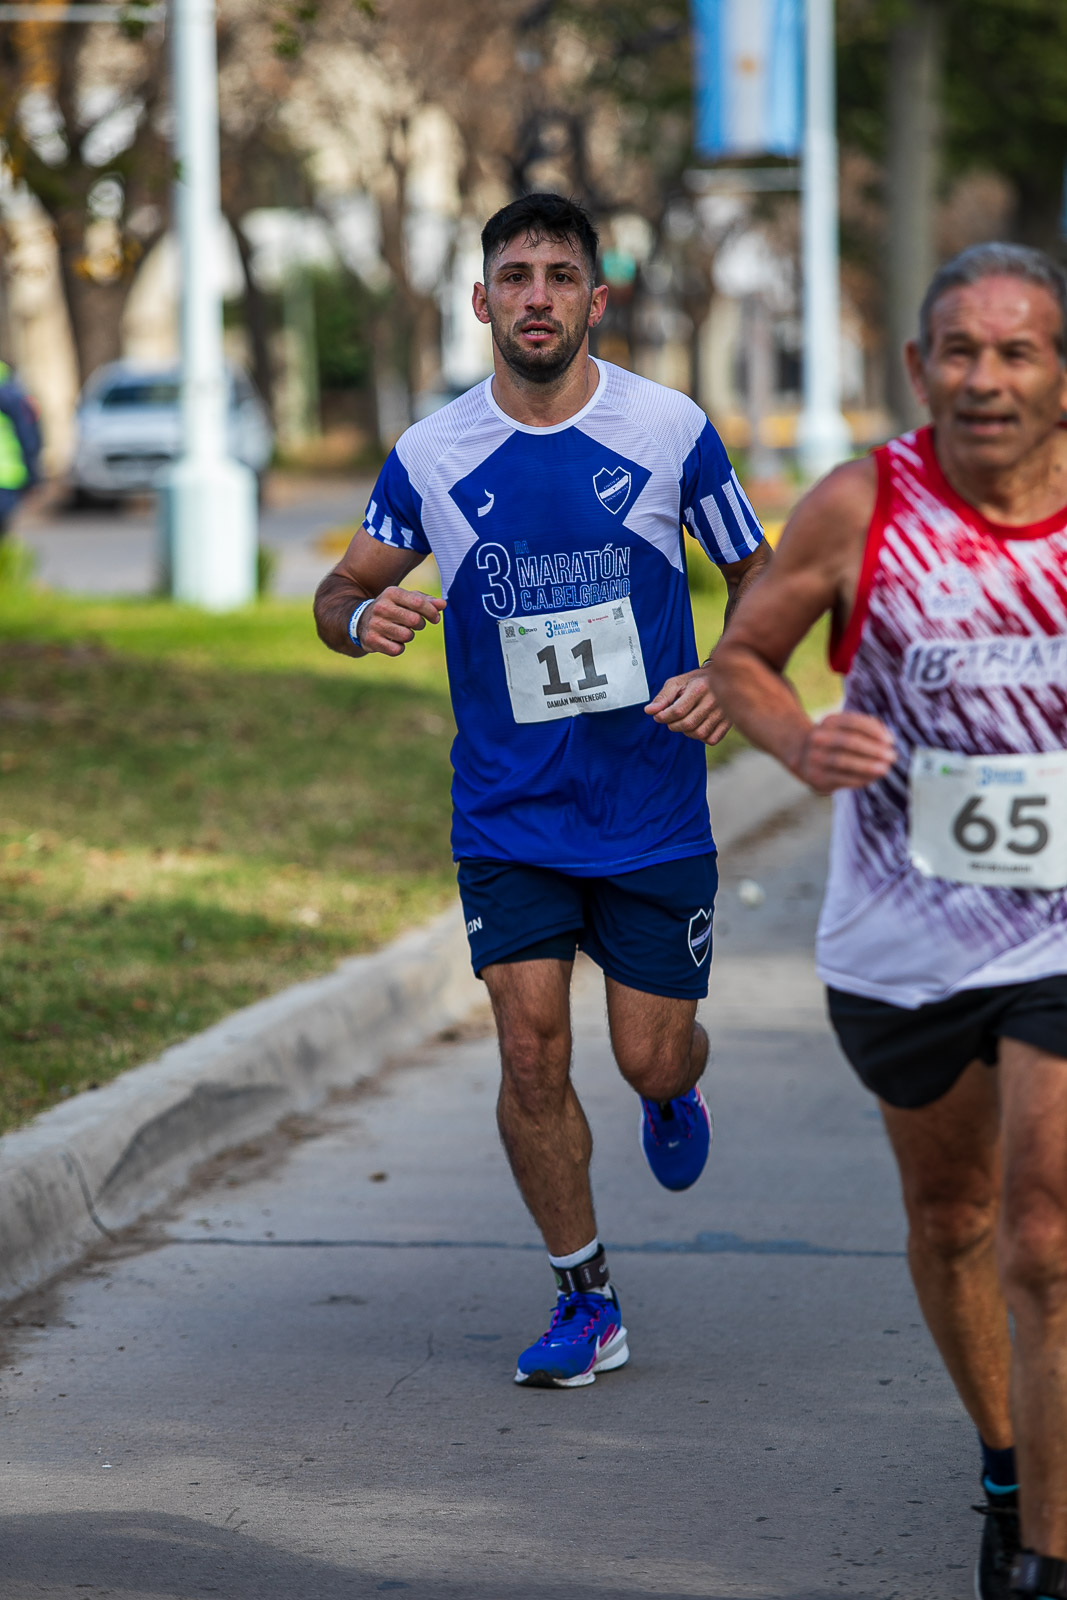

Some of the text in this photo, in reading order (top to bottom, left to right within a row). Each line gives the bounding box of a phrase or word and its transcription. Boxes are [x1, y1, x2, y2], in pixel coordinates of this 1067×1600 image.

[477, 542, 516, 619] 3
[516, 543, 631, 588] MARATÓN
[544, 620, 554, 638] 3
[553, 620, 579, 630] MARATÓN
[537, 638, 608, 696] 11
[547, 691, 607, 708] DAMIÁN MONTENEGRO
[953, 795, 1049, 855] 65
